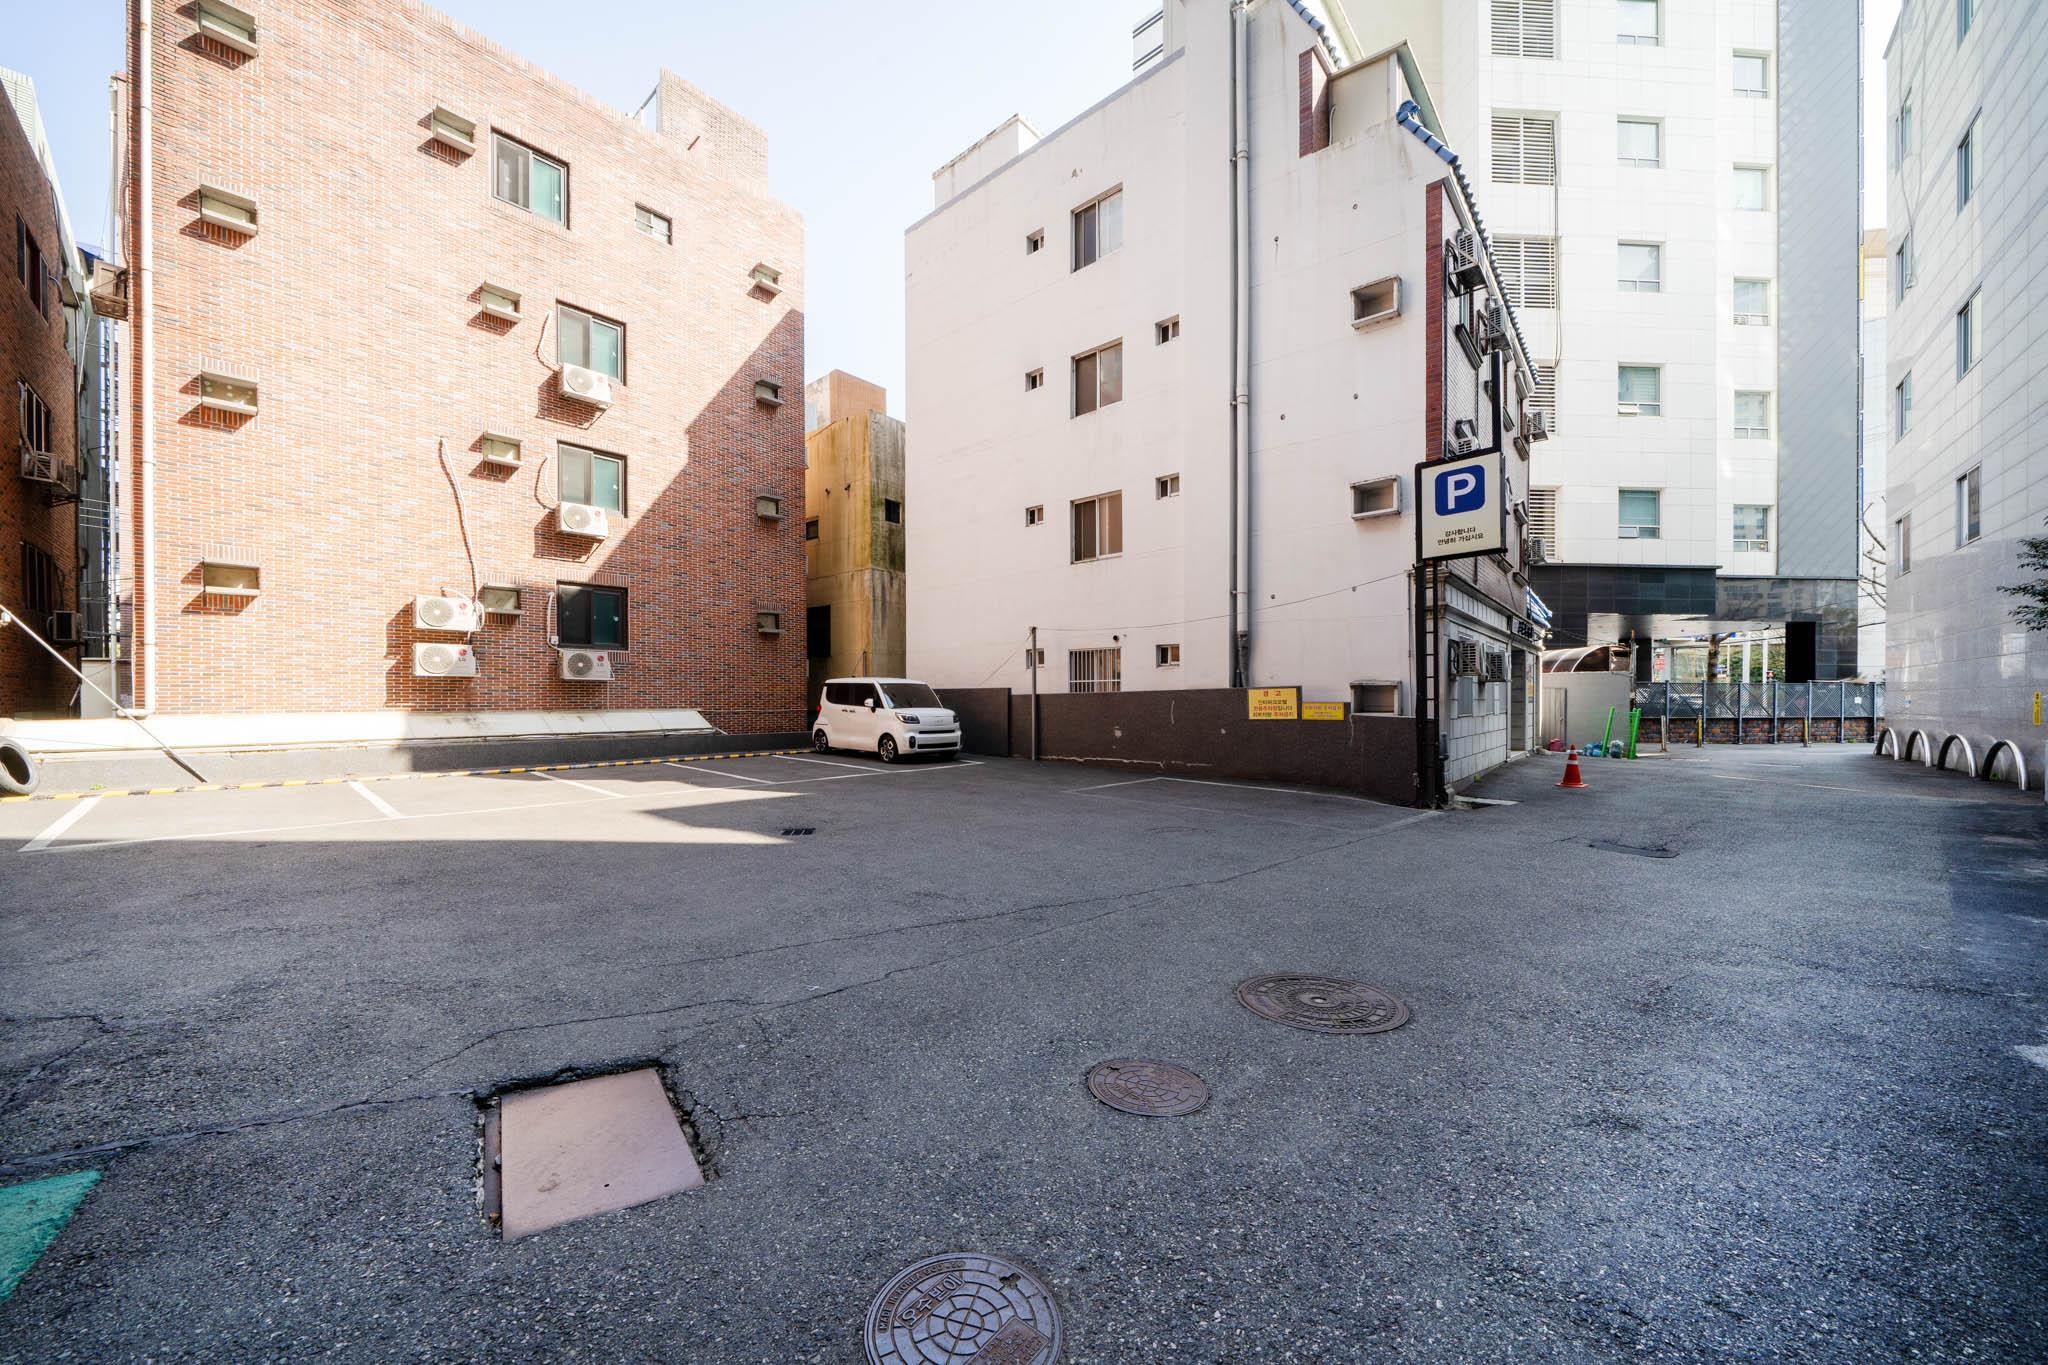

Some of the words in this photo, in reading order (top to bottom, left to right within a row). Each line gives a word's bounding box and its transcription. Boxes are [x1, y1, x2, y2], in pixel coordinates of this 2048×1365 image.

[1448, 473, 1476, 509] P
[1437, 537, 1456, 546] 안녕히
[1445, 527, 1475, 537] 감사합니다
[879, 1307, 892, 1330] MADE
[896, 1273, 924, 1295] KOREA
[902, 1274, 962, 1326] 오수받이
